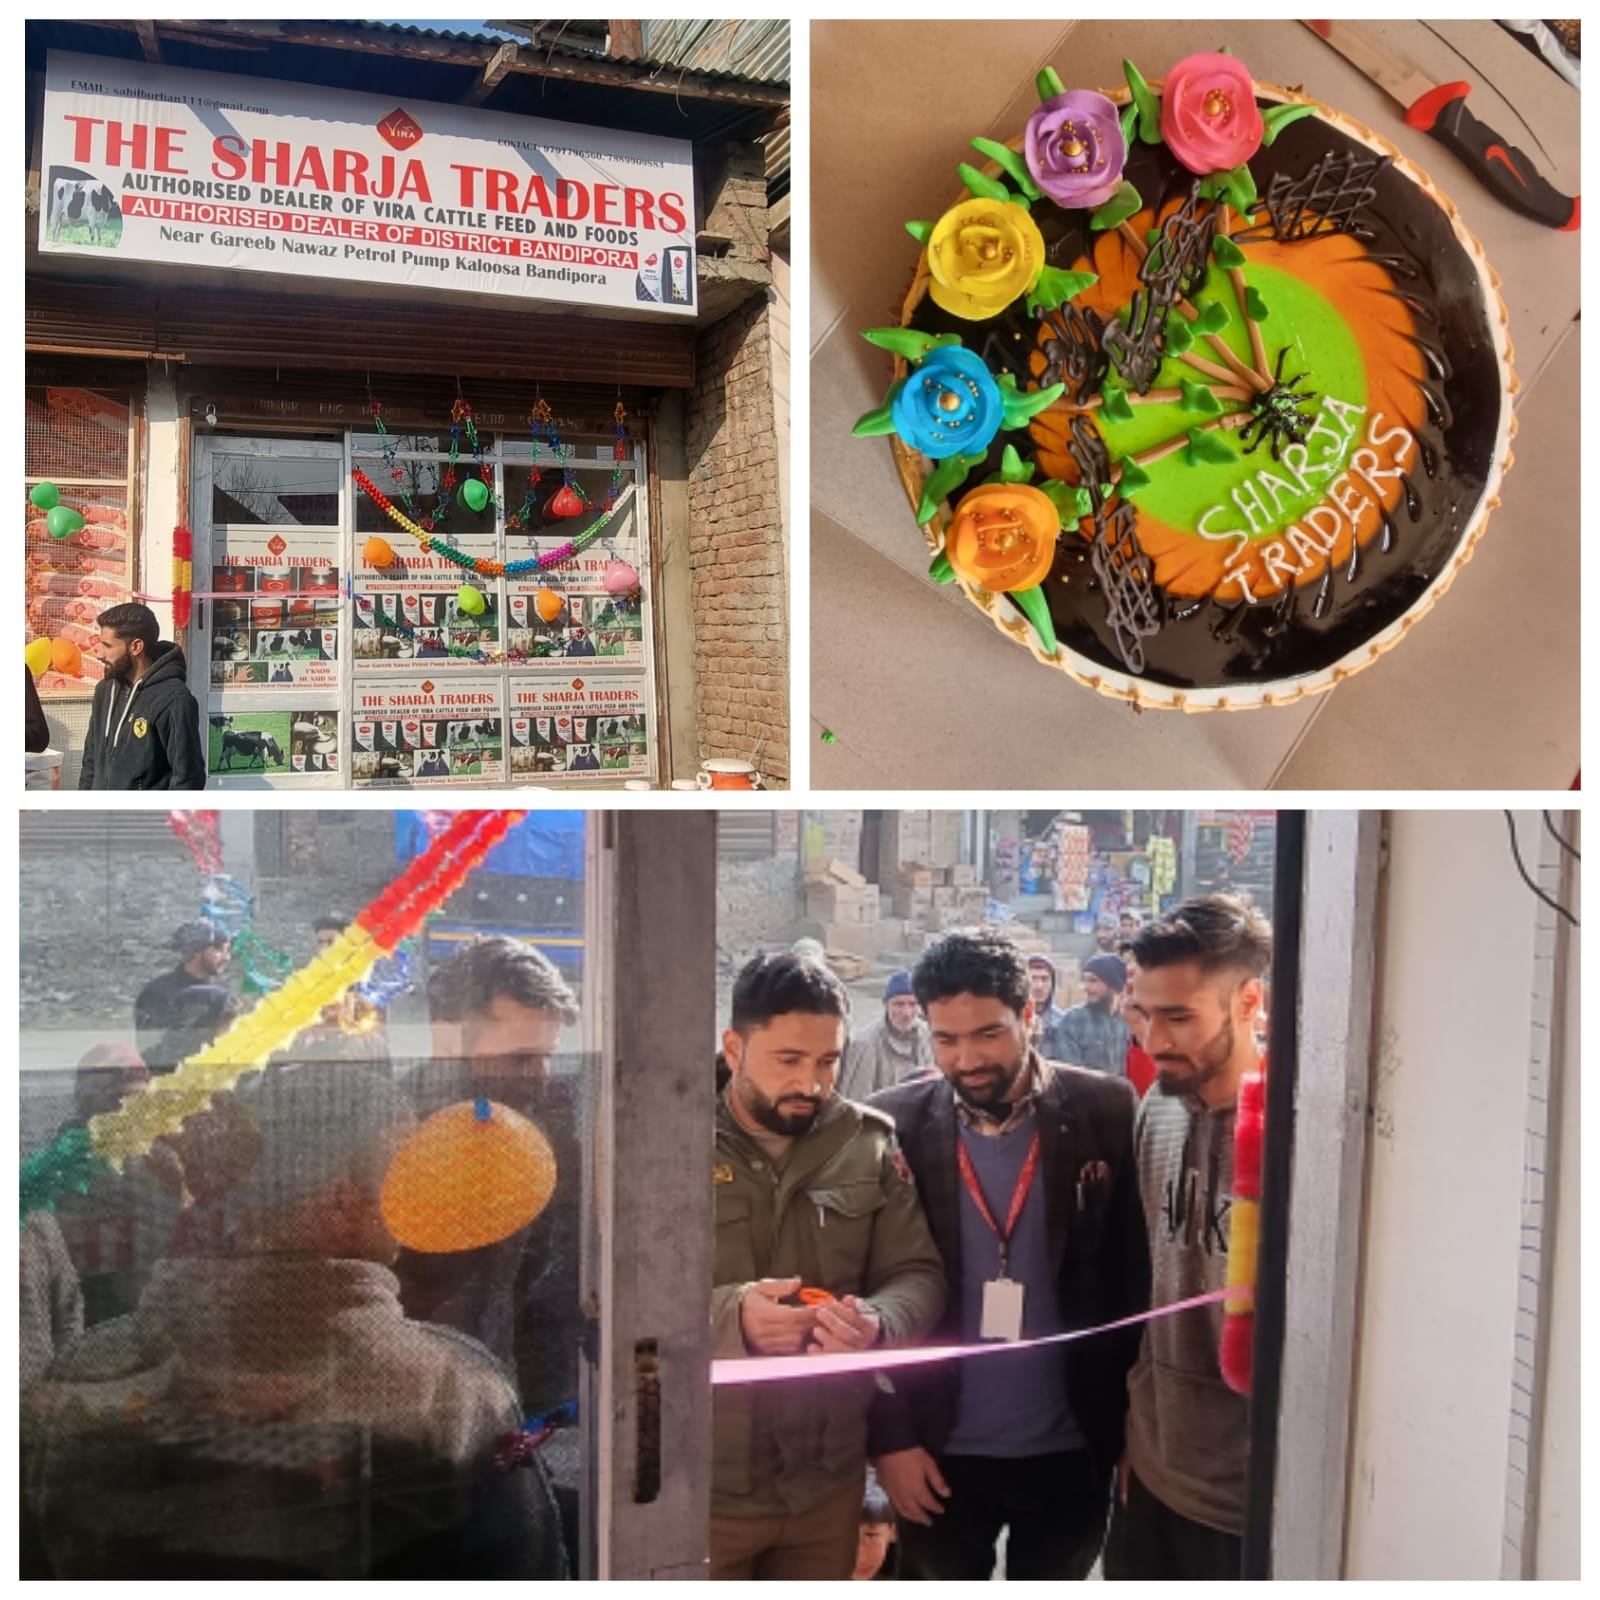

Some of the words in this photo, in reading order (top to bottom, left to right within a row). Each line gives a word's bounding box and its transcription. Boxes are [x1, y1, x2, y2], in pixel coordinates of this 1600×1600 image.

[64, 114, 189, 175] THE
[211, 135, 432, 203] SHARJA
[450, 163, 687, 234] TRADERS
[122, 172, 251, 201] AUTHORISED
[260, 187, 333, 213] DEALER
[341, 196, 365, 215] OF
[373, 200, 415, 221] VIRA
[424, 206, 487, 229] CATTLE
[495, 215, 537, 235] FEED
[544, 221, 578, 239] AND
[585, 225, 639, 247] FOODS
[131, 198, 284, 231] AUTHORISED
[291, 215, 379, 241] DEALER
[386, 225, 414, 242] OF
[421, 229, 515, 256] DISTRICT
[520, 240, 635, 268] BANDIPORA
[159, 225, 205, 245] Near
[210, 230, 276, 252] Gareeb
[282, 238, 338, 258] Nawaz
[343, 243, 396, 264] Petrol
[402, 250, 450, 271] Pump
[455, 256, 521, 276] Kaloosa
[526, 262, 607, 286] Bandipora
[1198, 394, 1367, 568] SHARJA
[1222, 412, 1413, 605] TRADERS
[220, 555, 241, 566] THE
[244, 555, 283, 567] SHARJA
[287, 556, 333, 567] TRADERS
[390, 556, 434, 569] SHARJA
[361, 695, 385, 707] THE
[389, 694, 435, 706] SHARJA
[439, 693, 494, 705] TRADERS
[517, 692, 538, 703] THE
[542, 691, 585, 702] SHARJA
[589, 690, 639, 701] TRADERS
